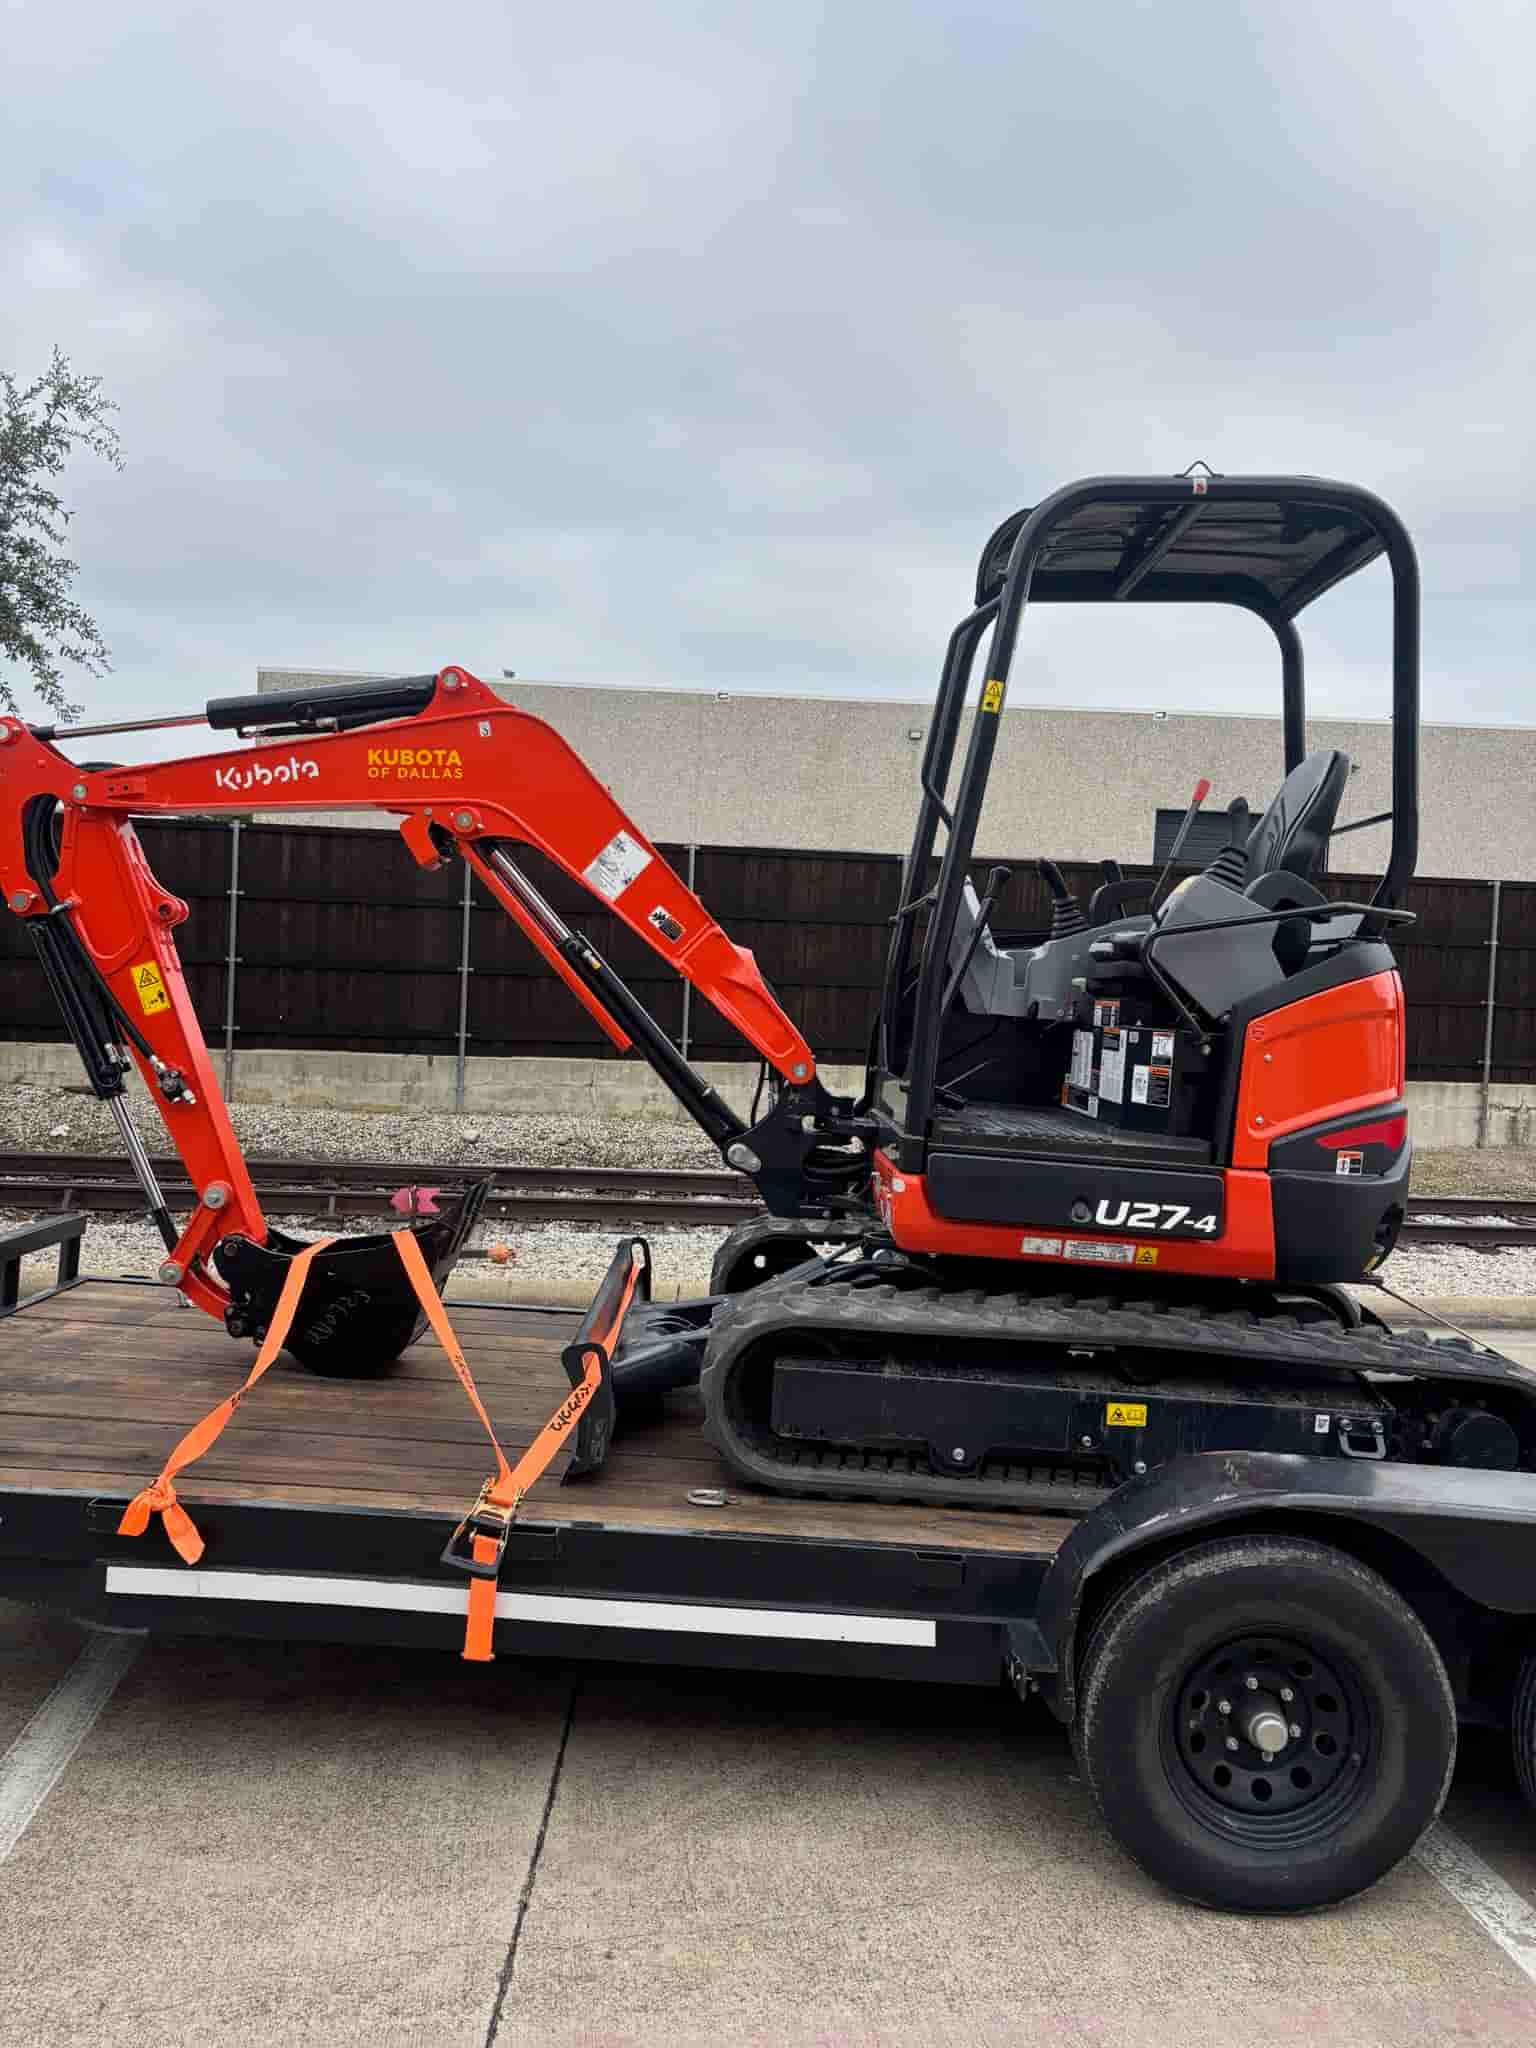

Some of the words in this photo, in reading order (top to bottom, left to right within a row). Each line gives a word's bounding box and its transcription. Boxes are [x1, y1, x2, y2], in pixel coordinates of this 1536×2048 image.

[367, 749, 463, 766] KUBOTA
[367, 766, 389, 779] OF
[397, 767, 464, 779] DALLAS
[1095, 1199, 1217, 1233] U27-4
